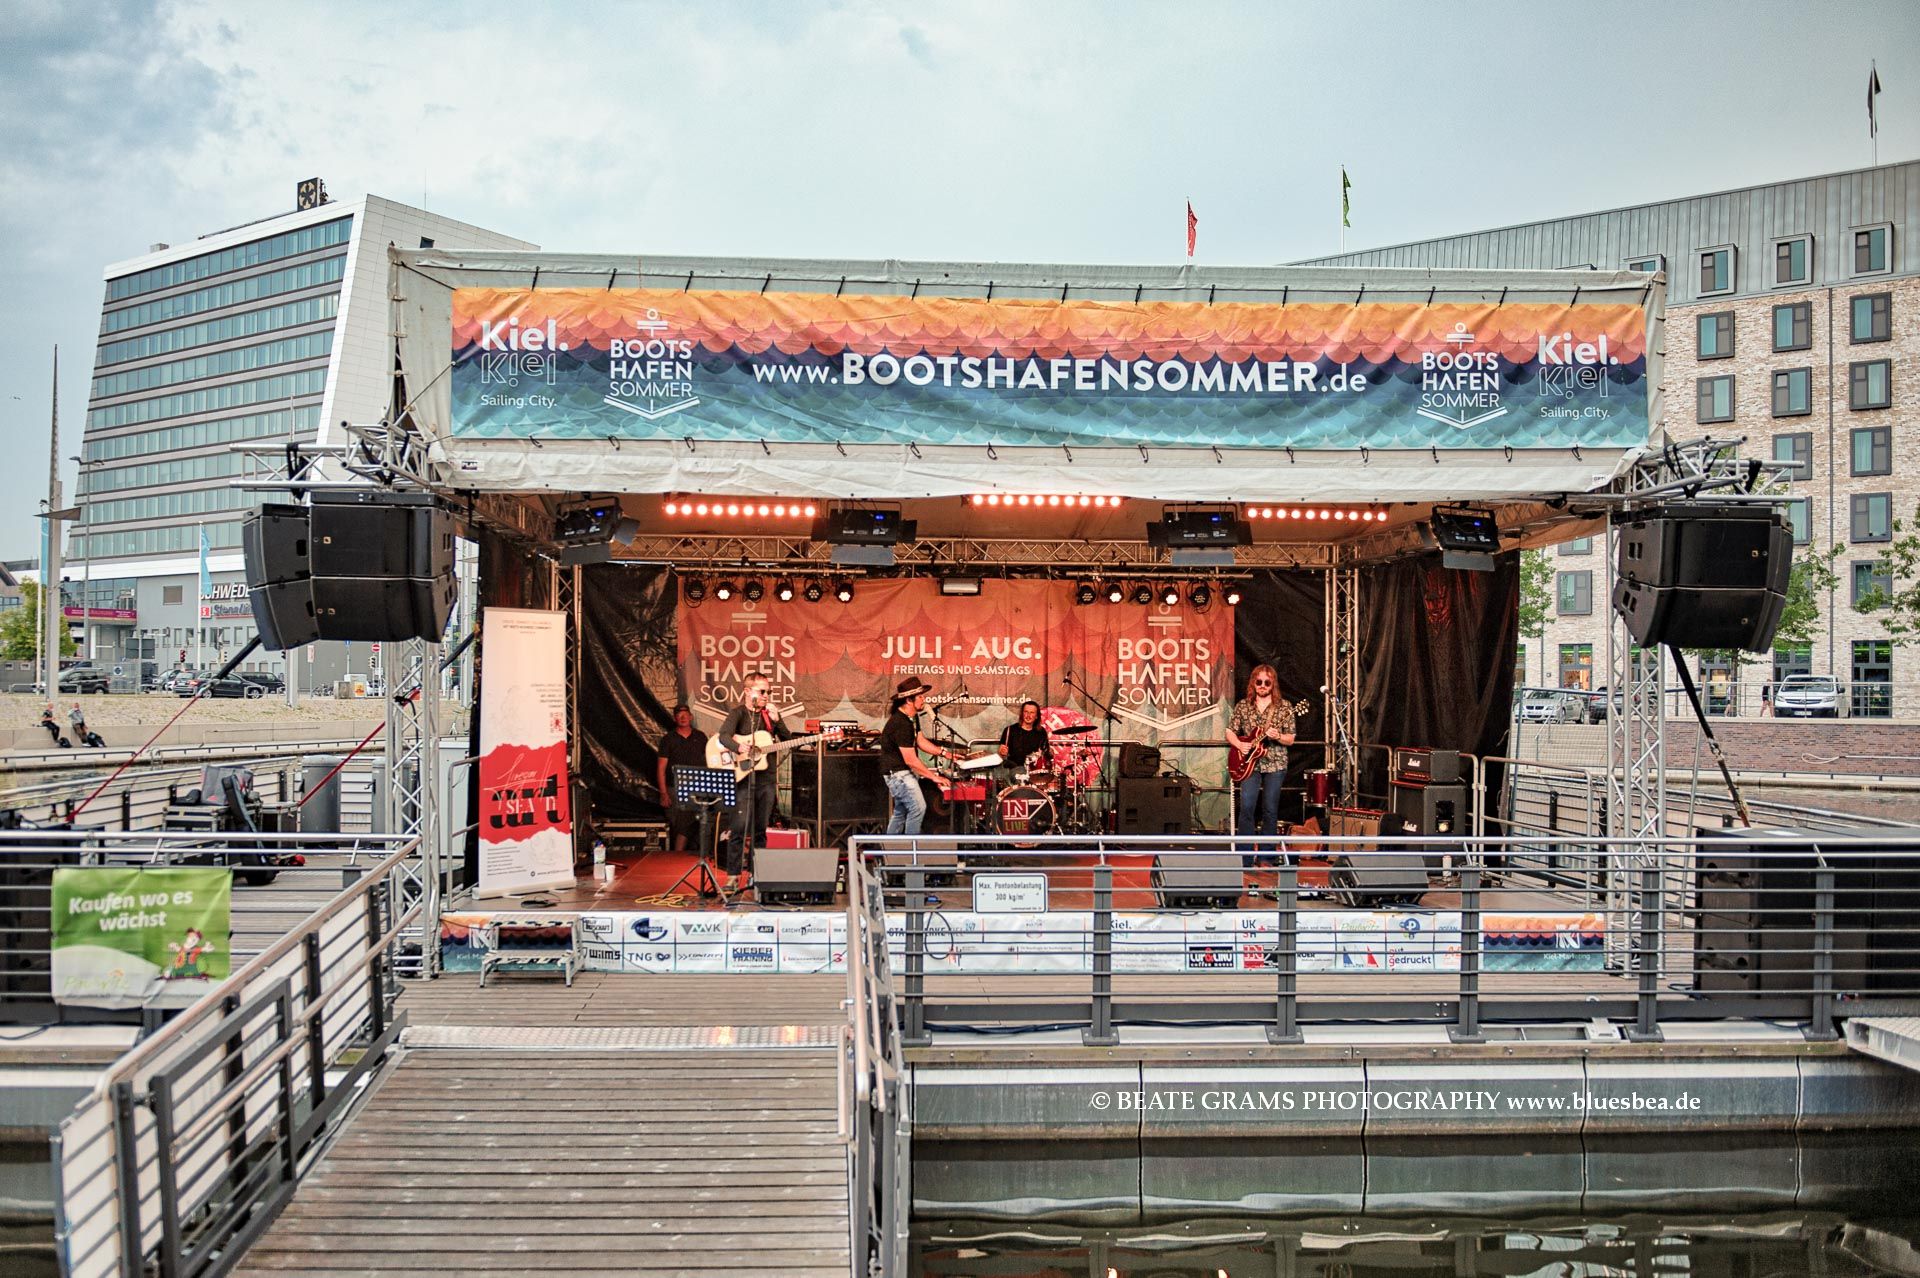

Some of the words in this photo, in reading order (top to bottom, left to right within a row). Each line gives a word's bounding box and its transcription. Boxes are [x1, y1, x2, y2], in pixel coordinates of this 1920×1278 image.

[482, 316, 569, 352] Kiel.
[610, 339, 693, 360] BOOTS
[1538, 332, 1619, 366] Kiel.
[610, 361, 693, 381] HAFEN
[1421, 352, 1499, 372] BOOTS
[752, 352, 1367, 393] www.BOOTSHAFENSOMMER.de
[1422, 372, 1500, 391] HAFEN
[609, 381, 693, 398] SOMMER
[1422, 393, 1500, 409] SOMMER
[700, 635, 796, 658] BOOTS
[881, 636, 942, 659] JULI
[970, 636, 1042, 660] AUG.
[1118, 638, 1211, 661] BOOTS
[700, 660, 796, 683] HAFEN
[893, 664, 945, 675] FREITAGS
[947, 665, 972, 675] UND
[974, 665, 1031, 676] SAMSTAGS
[1118, 662, 1211, 685] HAFEN
[700, 684, 796, 703] SOMER
[1117, 687, 1211, 705] SOMMER
[1004, 820, 1028, 832] LIVE
[978, 882, 992, 890] Max.
[994, 882, 1042, 891] Pontonbelastung
[69, 892, 136, 915] Kaufen
[139, 892, 169, 908] wo
[172, 890, 193, 905] es
[995, 893, 1006, 901] 300
[98, 911, 168, 932] wächst
[1242, 919, 1257, 929] UK
[627, 952, 653, 962] TNG
[732, 947, 773, 955] KIESER
[732, 955, 773, 963] TRAINING
[1389, 955, 1431, 967] gedruckt
